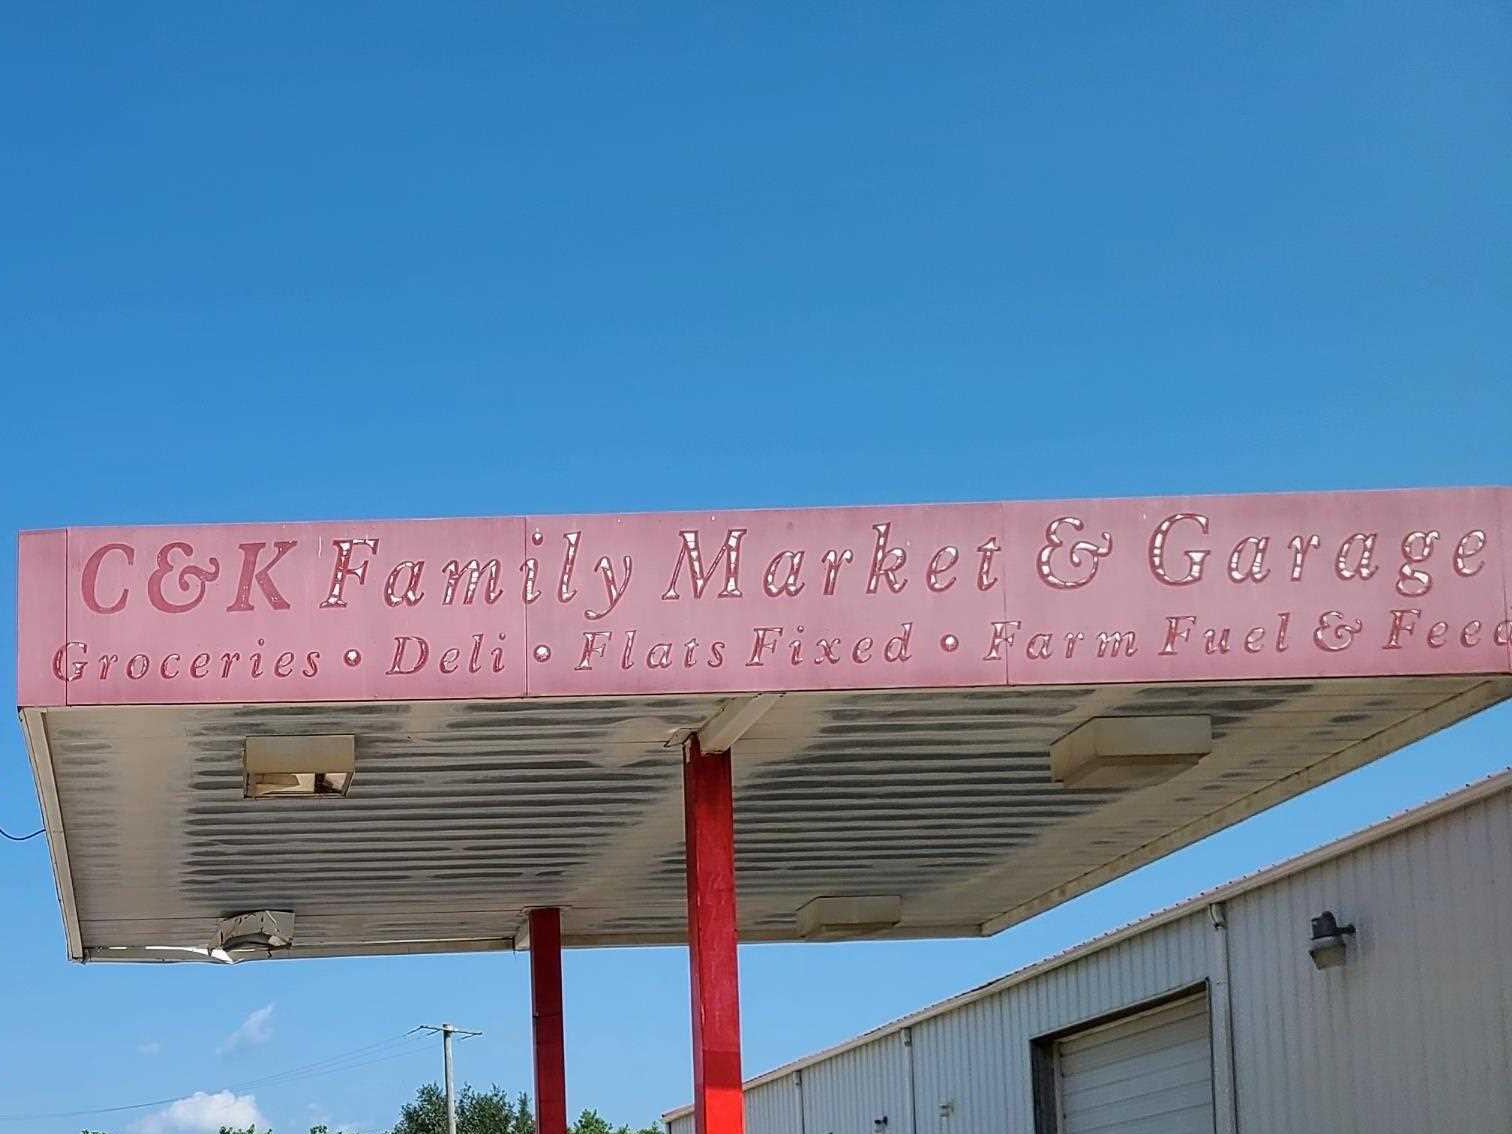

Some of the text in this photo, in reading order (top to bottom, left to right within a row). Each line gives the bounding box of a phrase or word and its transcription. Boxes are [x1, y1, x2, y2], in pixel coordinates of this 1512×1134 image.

[80, 512, 1487, 620] C&K Family Market & Garage
[52, 638, 321, 683] Groceries
[386, 633, 508, 677] Deli
[574, 629, 726, 672] Flats
[744, 622, 913, 666] Fixed
[984, 619, 1138, 662] Farm
[1158, 612, 1290, 658] Fuel
[1313, 610, 1362, 652] &
